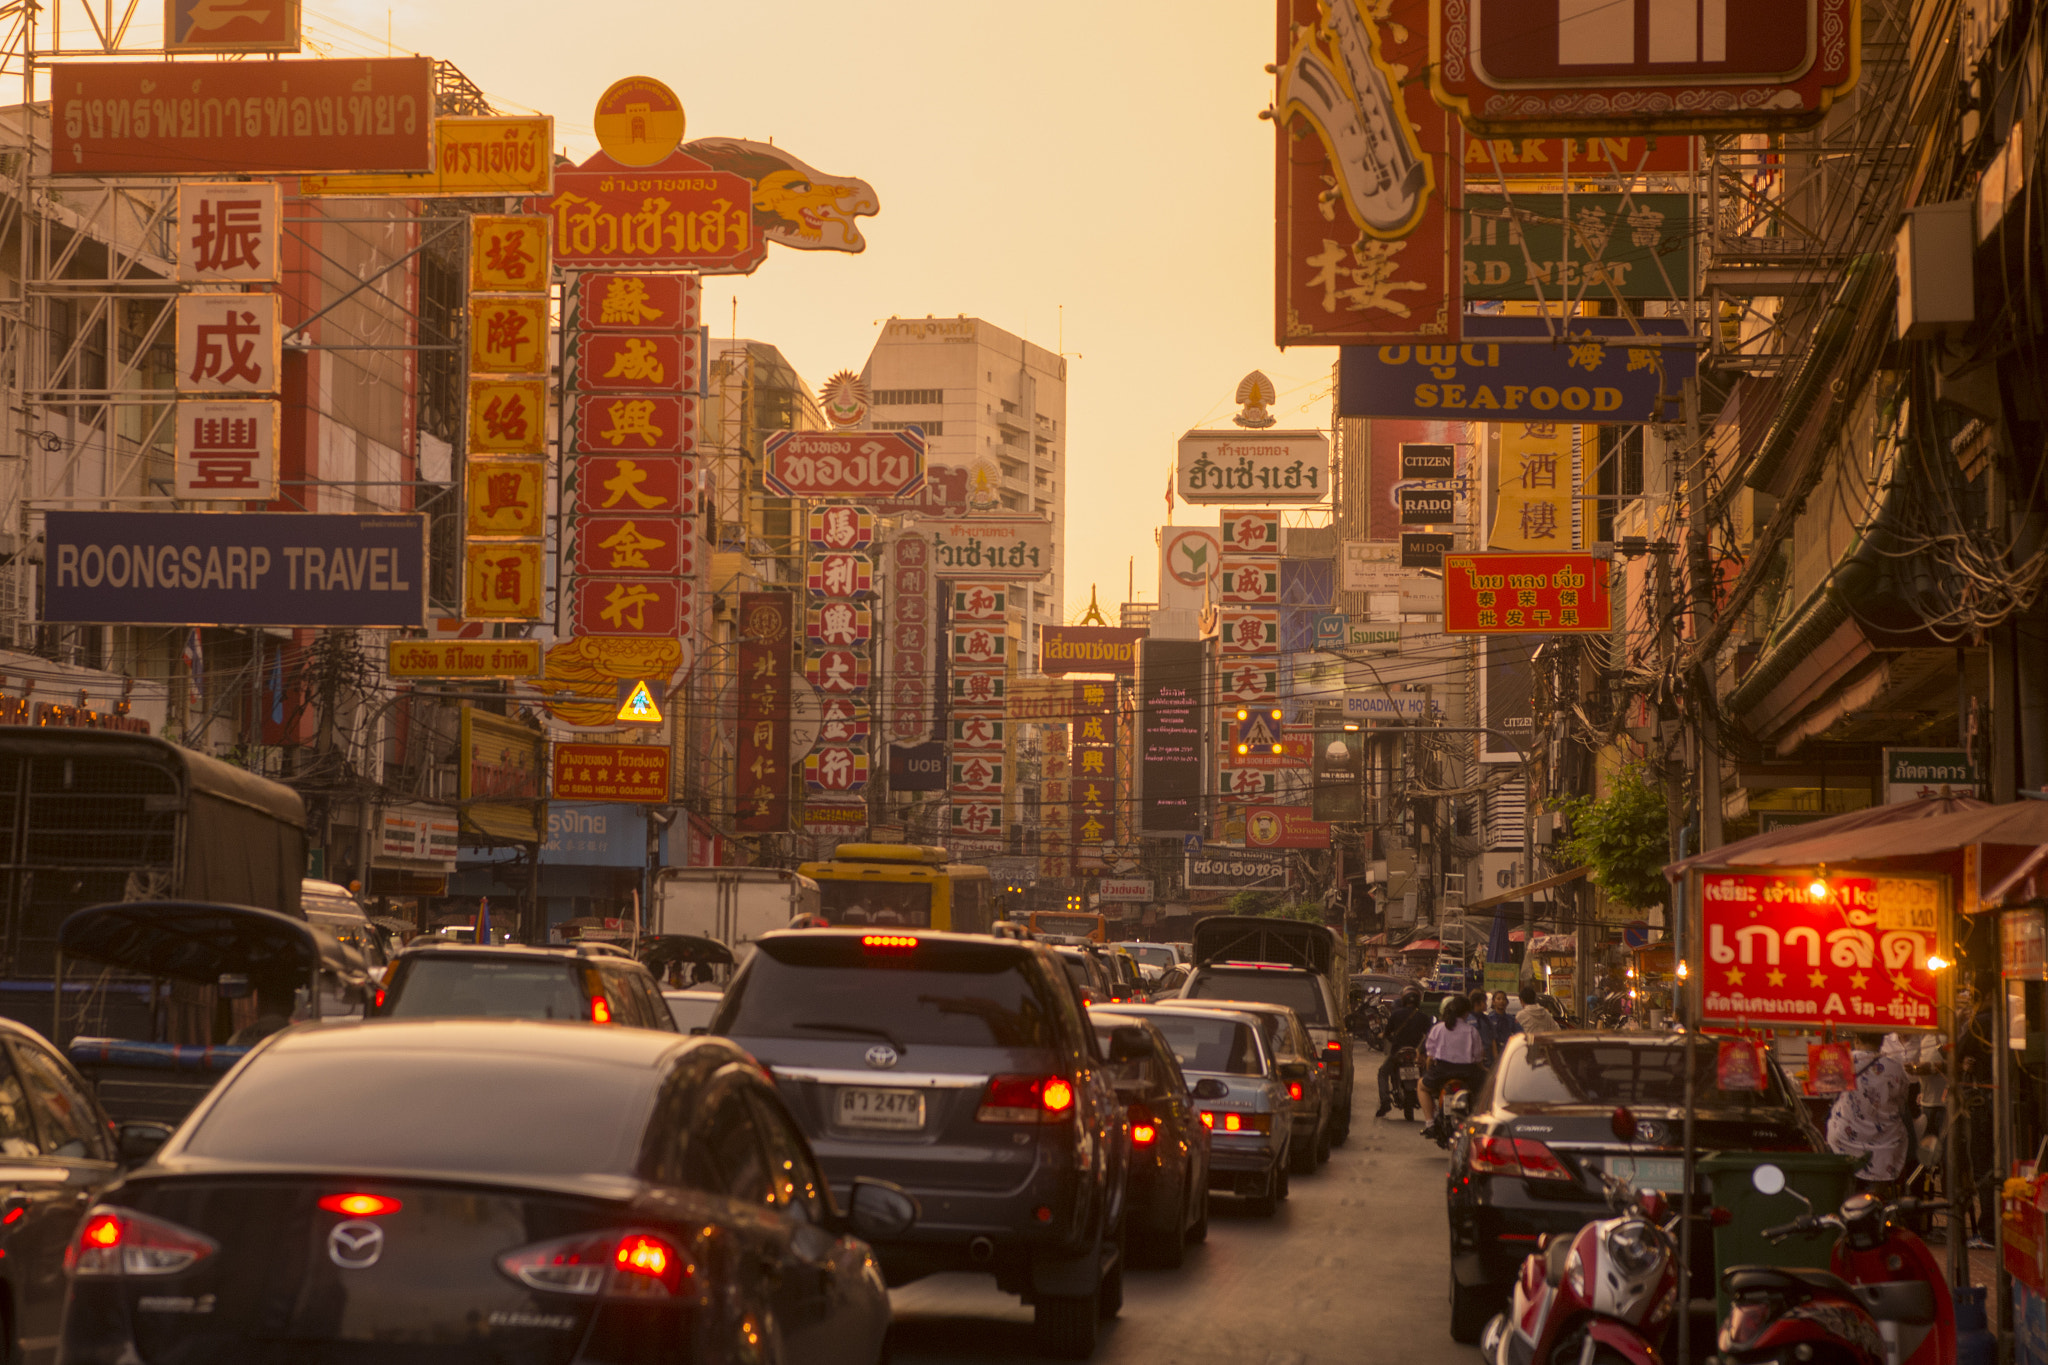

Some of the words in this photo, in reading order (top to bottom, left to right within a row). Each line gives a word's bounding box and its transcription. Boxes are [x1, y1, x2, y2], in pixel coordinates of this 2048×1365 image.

[64, 65, 417, 164] รุ่งทรัพย์การท่องเที่ยว
[1525, 259, 1632, 287] NEST
[1414, 383, 1624, 411] SEAFOOD
[784, 441, 910, 486] ทองใบ
[1404, 456, 1451, 467] CITIZEN
[1404, 499, 1451, 511] RADO
[1410, 543, 1445, 553] MIDO
[57, 544, 271, 589] ROONGSARP
[283, 547, 410, 591] TRAVEL
[1467, 571, 1504, 589] ไทย
[1509, 572, 1546, 589] หลง
[1479, 609, 1579, 626] 批发干果
[399, 648, 439, 669] บริษัท
[1349, 698, 1405, 713] BROADWAY
[1409, 699, 1442, 714] HOEL
[751, 650, 778, 815] 北京同仁堂
[908, 759, 942, 772] UOB
[1895, 760, 1966, 780] ภัตตาคาร
[1081, 684, 1105, 875] 聯成興大金
[804, 809, 866, 821] EXCHANGE
[1854, 886, 1877, 909] kg
[1709, 909, 1928, 970] เกาลัด
[1823, 992, 1846, 1015] A
[874, 1093, 917, 1112] 2479
